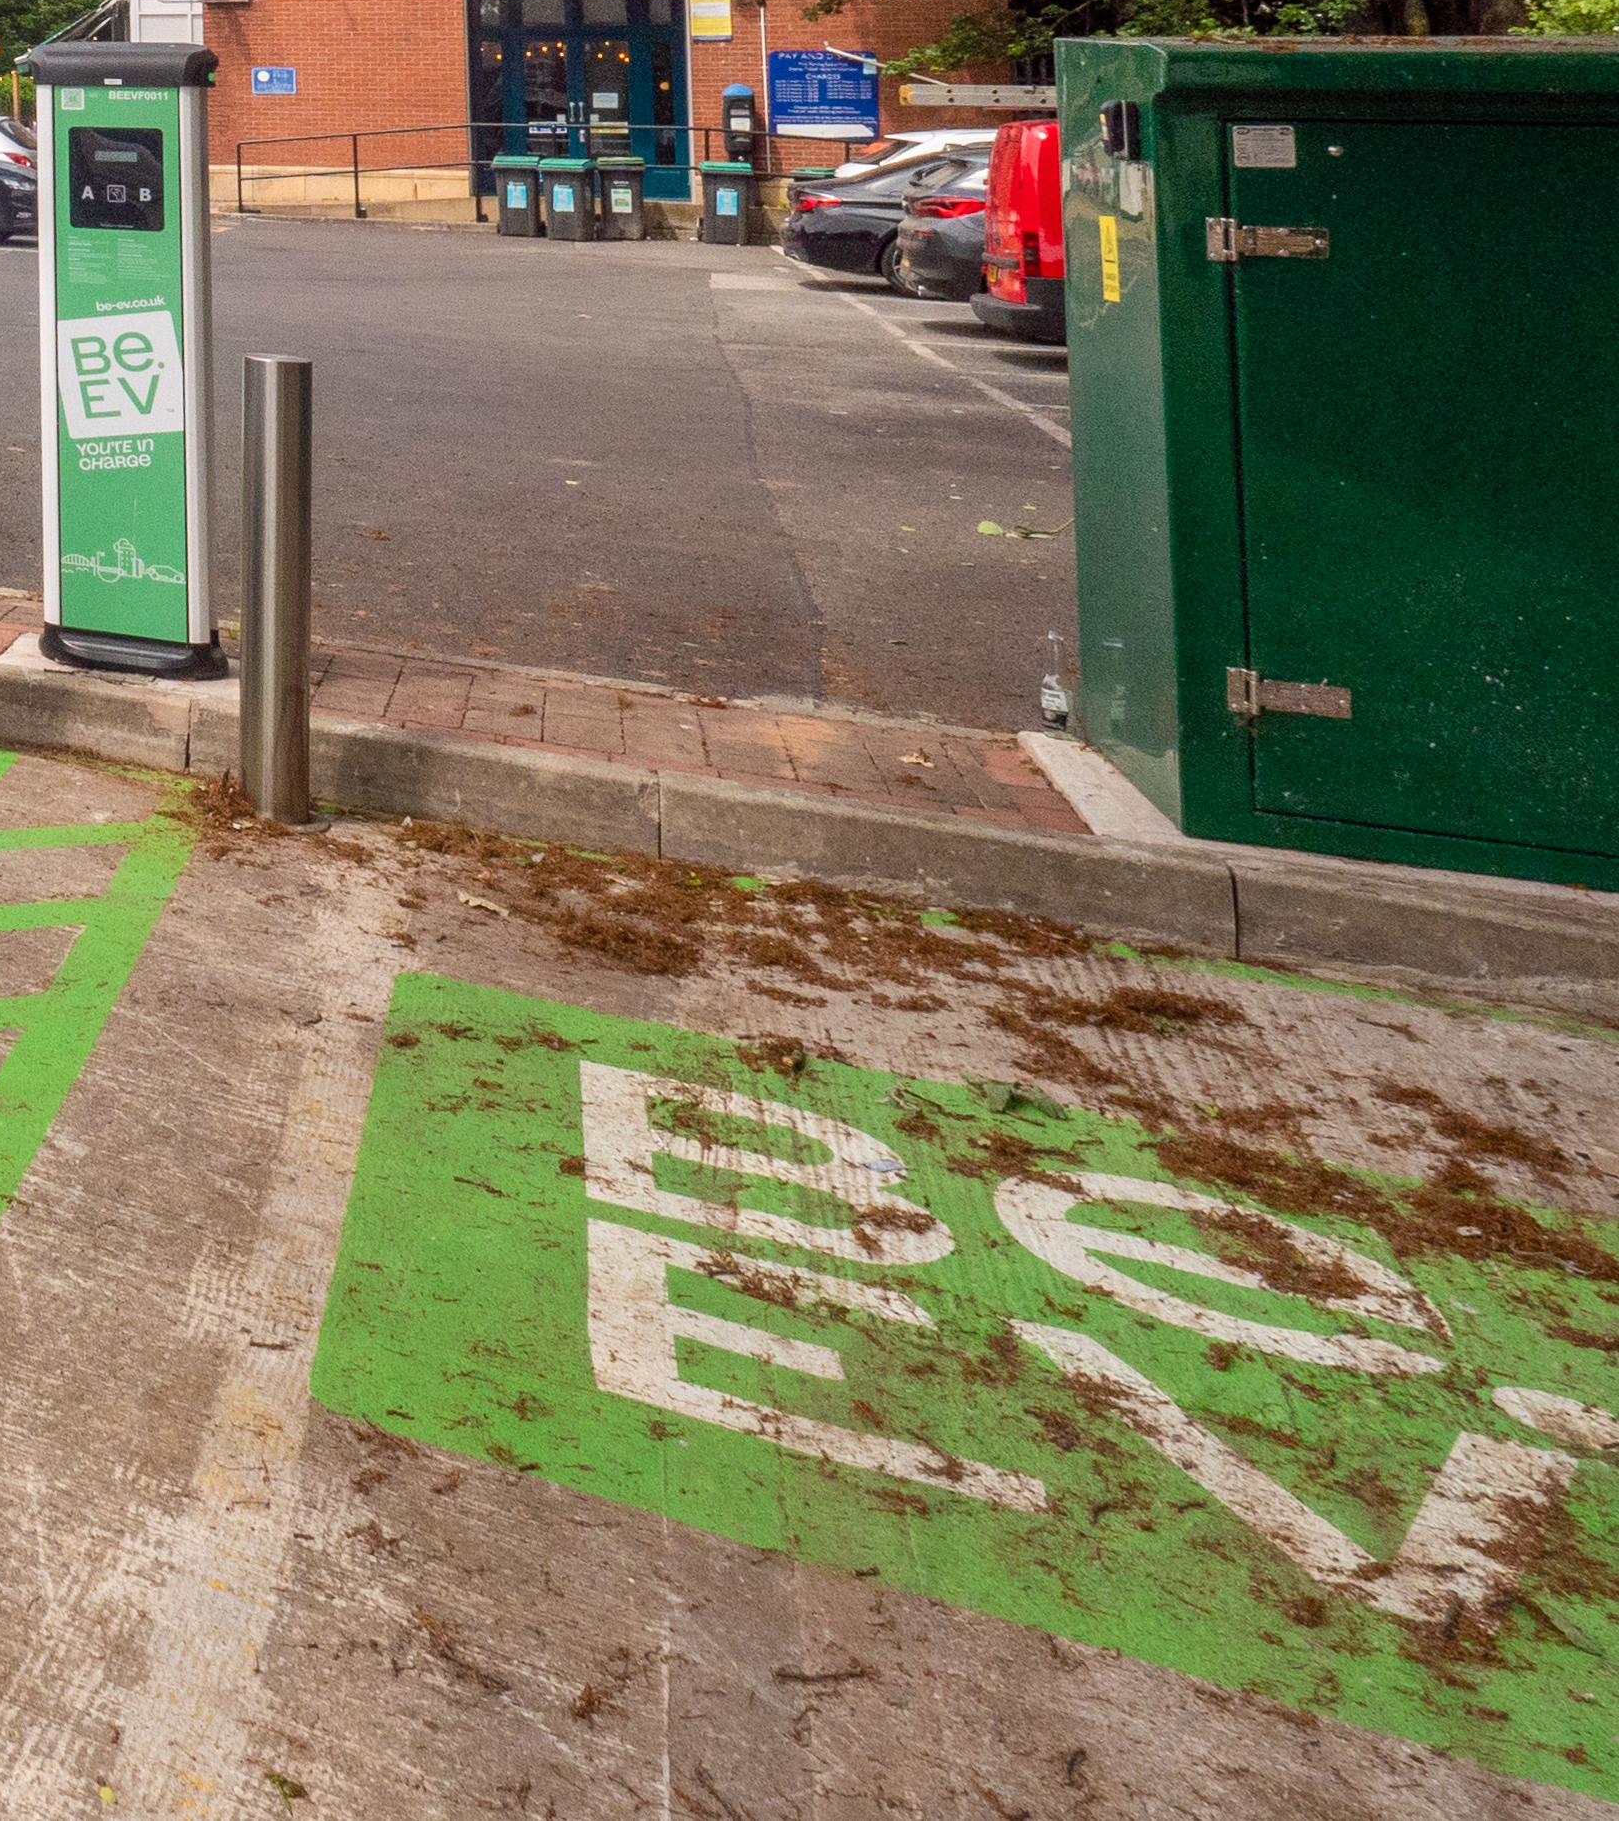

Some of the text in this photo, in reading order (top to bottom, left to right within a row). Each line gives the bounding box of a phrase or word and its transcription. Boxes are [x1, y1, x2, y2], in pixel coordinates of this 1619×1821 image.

[777, 52, 798, 60] PAY
[81, 185, 95, 200] A
[138, 187, 152, 202] B
[95, 295, 166, 312] be-ev.co.uk
[79, 374, 160, 419] EV
[586, 1217, 1578, 1624] EV
